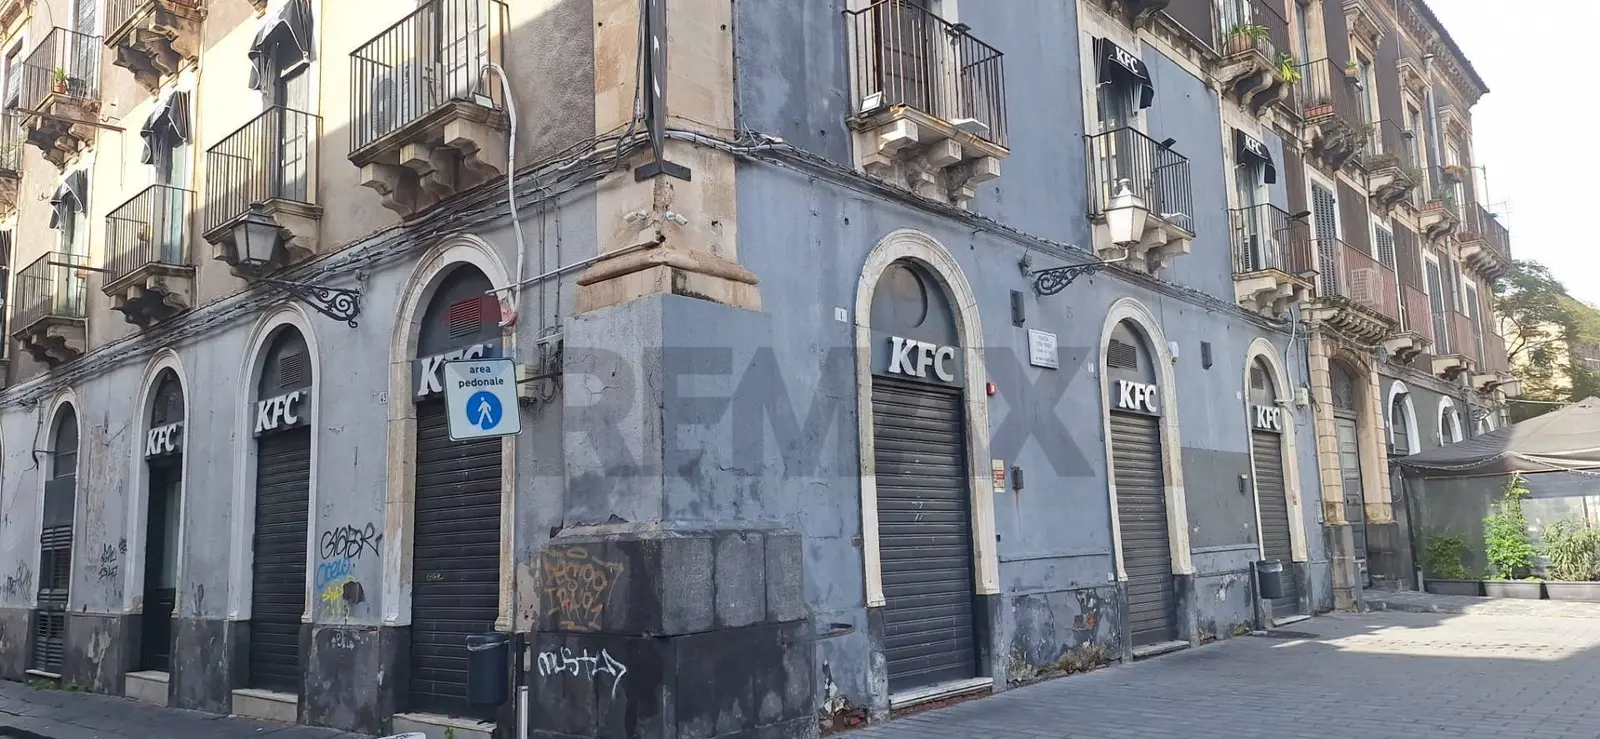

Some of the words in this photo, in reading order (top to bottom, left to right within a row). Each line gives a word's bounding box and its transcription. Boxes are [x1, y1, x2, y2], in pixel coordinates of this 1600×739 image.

[1115, 46, 1138, 73] KFC
[1245, 134, 1262, 155] KFC
[469, 365, 491, 374] area
[888, 335, 955, 382] KFC
[458, 376, 504, 389] pedonale
[1119, 379, 1157, 412] KFC
[254, 390, 300, 433] KFC
[1256, 404, 1281, 430] KFC
[144, 422, 178, 457] KFC
